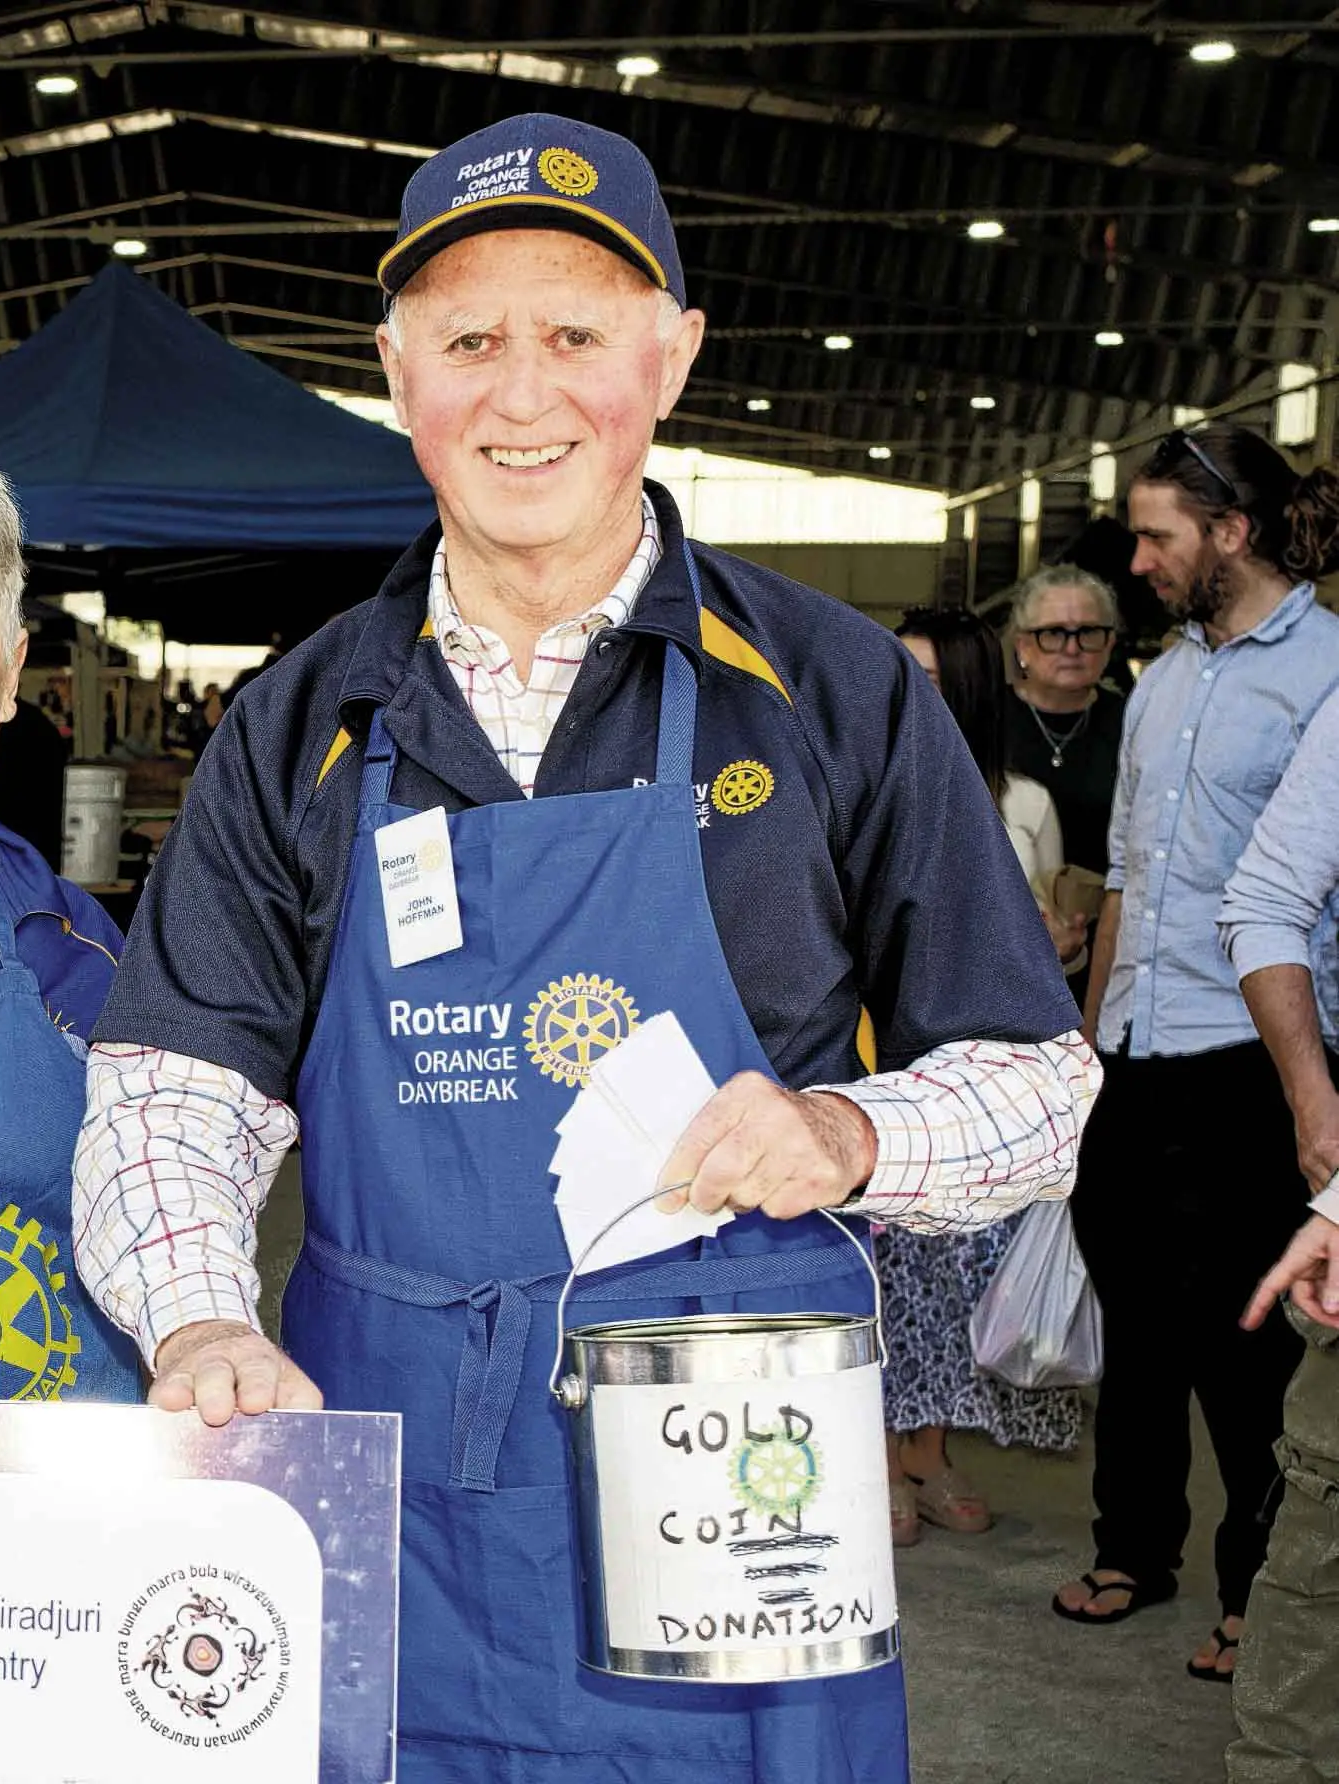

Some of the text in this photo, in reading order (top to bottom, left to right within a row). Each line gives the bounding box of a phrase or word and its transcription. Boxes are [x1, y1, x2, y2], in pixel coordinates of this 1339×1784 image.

[456, 147, 534, 181] Rotary
[468, 167, 530, 192] ORANGE
[451, 180, 529, 209] DAYBREAK
[382, 853, 416, 872] Rotary
[398, 904, 444, 927] HOFFMAN
[407, 896, 432, 912] JOHN
[389, 1000, 512, 1040] Rotary
[414, 1046, 518, 1074] ORANGE
[398, 1078, 519, 1105] DAYBREAK
[662, 1402, 814, 1455] GOLD
[659, 1504, 803, 1544] COIN
[118, 1641, 132, 1685] marra
[146, 1569, 186, 1597] marra
[190, 1564, 218, 1578] bula
[658, 1592, 874, 1645] DONATION
